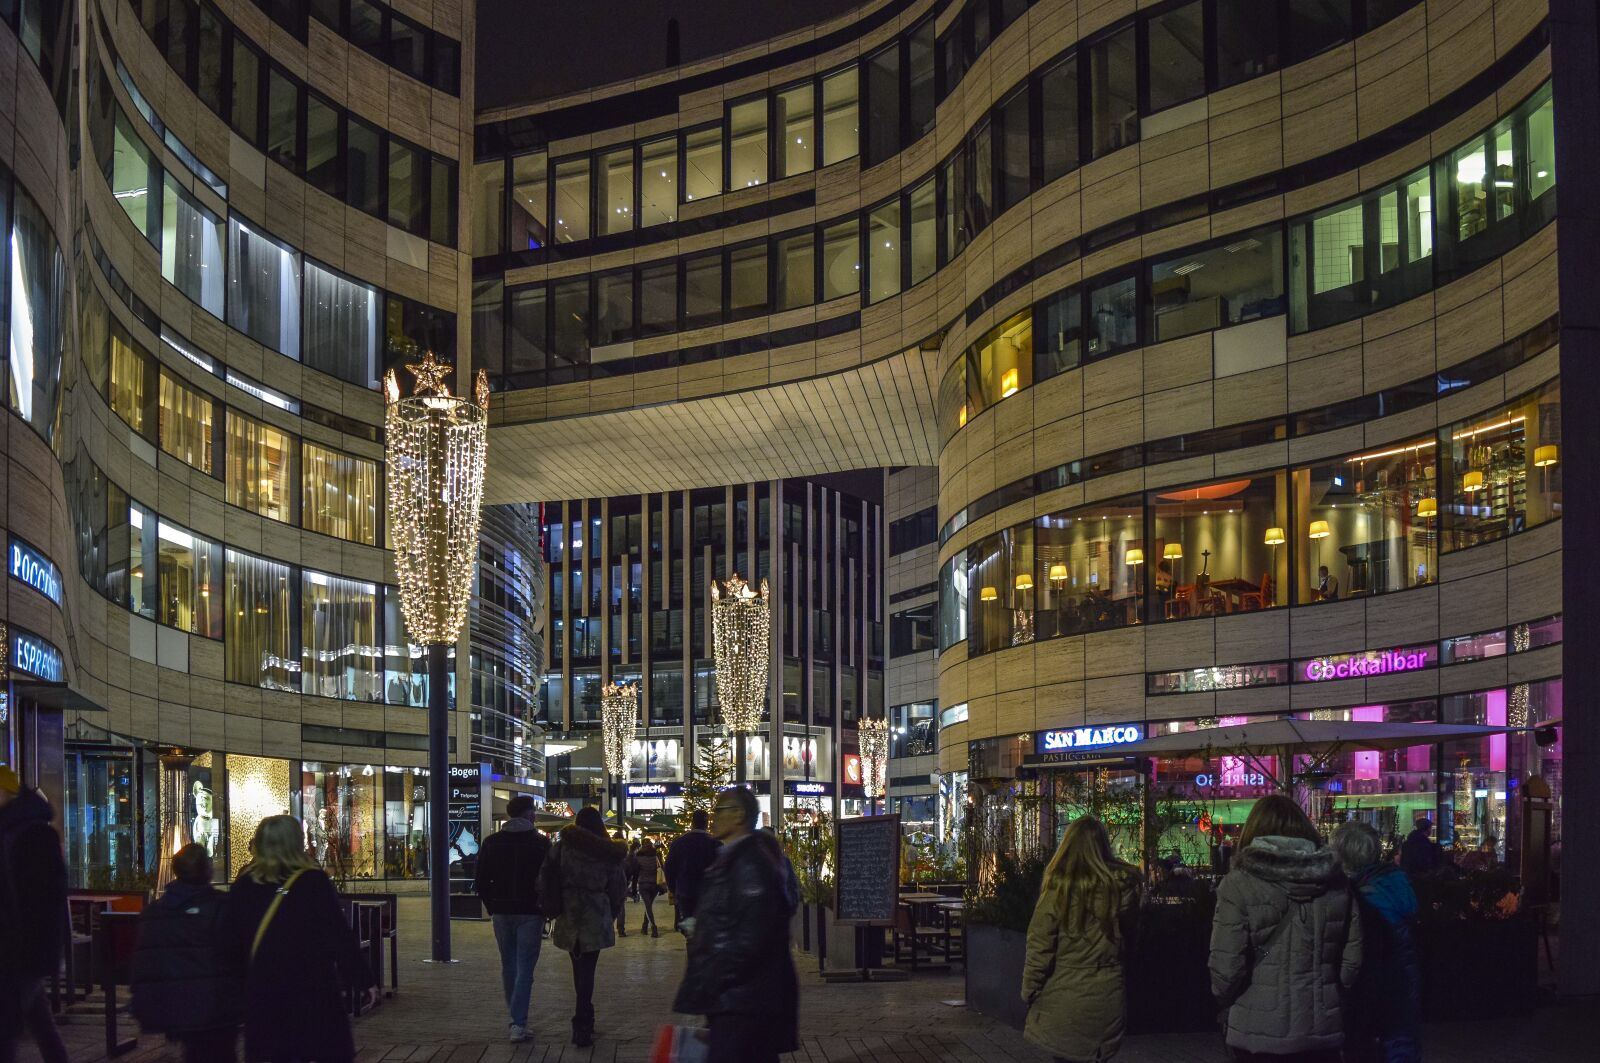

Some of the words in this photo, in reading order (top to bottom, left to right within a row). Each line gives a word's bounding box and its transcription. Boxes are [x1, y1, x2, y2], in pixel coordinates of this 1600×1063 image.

[1306, 650, 1428, 680] Cocktailbar
[1045, 732, 1074, 749] SAN
[628, 784, 660, 794] swatch
